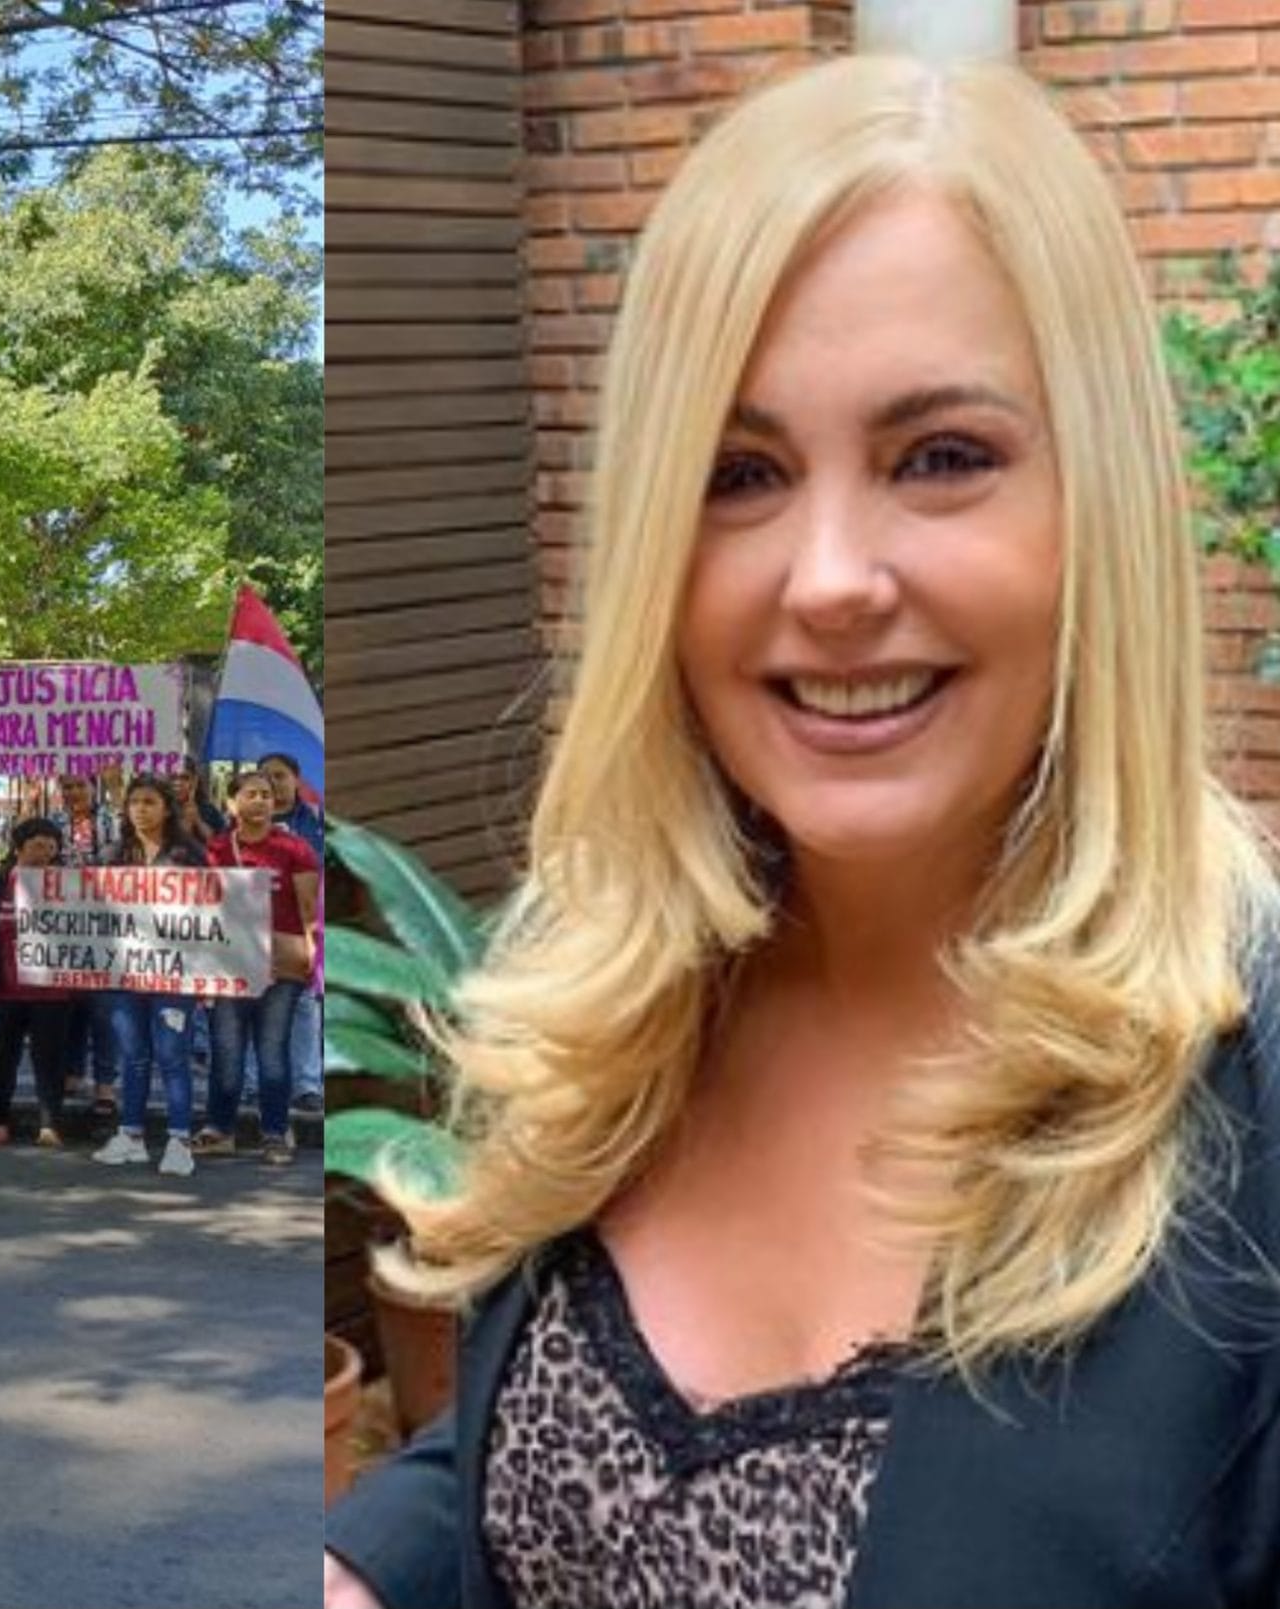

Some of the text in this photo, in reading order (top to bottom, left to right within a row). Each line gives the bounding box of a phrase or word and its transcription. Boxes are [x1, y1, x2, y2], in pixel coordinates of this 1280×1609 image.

[47, 709, 155, 747] MENCHI
[43, 867, 225, 907] EL MACHISMO
[152, 913, 232, 946] VIOLA,
[19, 942, 96, 970] GOLPEA
[125, 948, 185, 977] MATA
